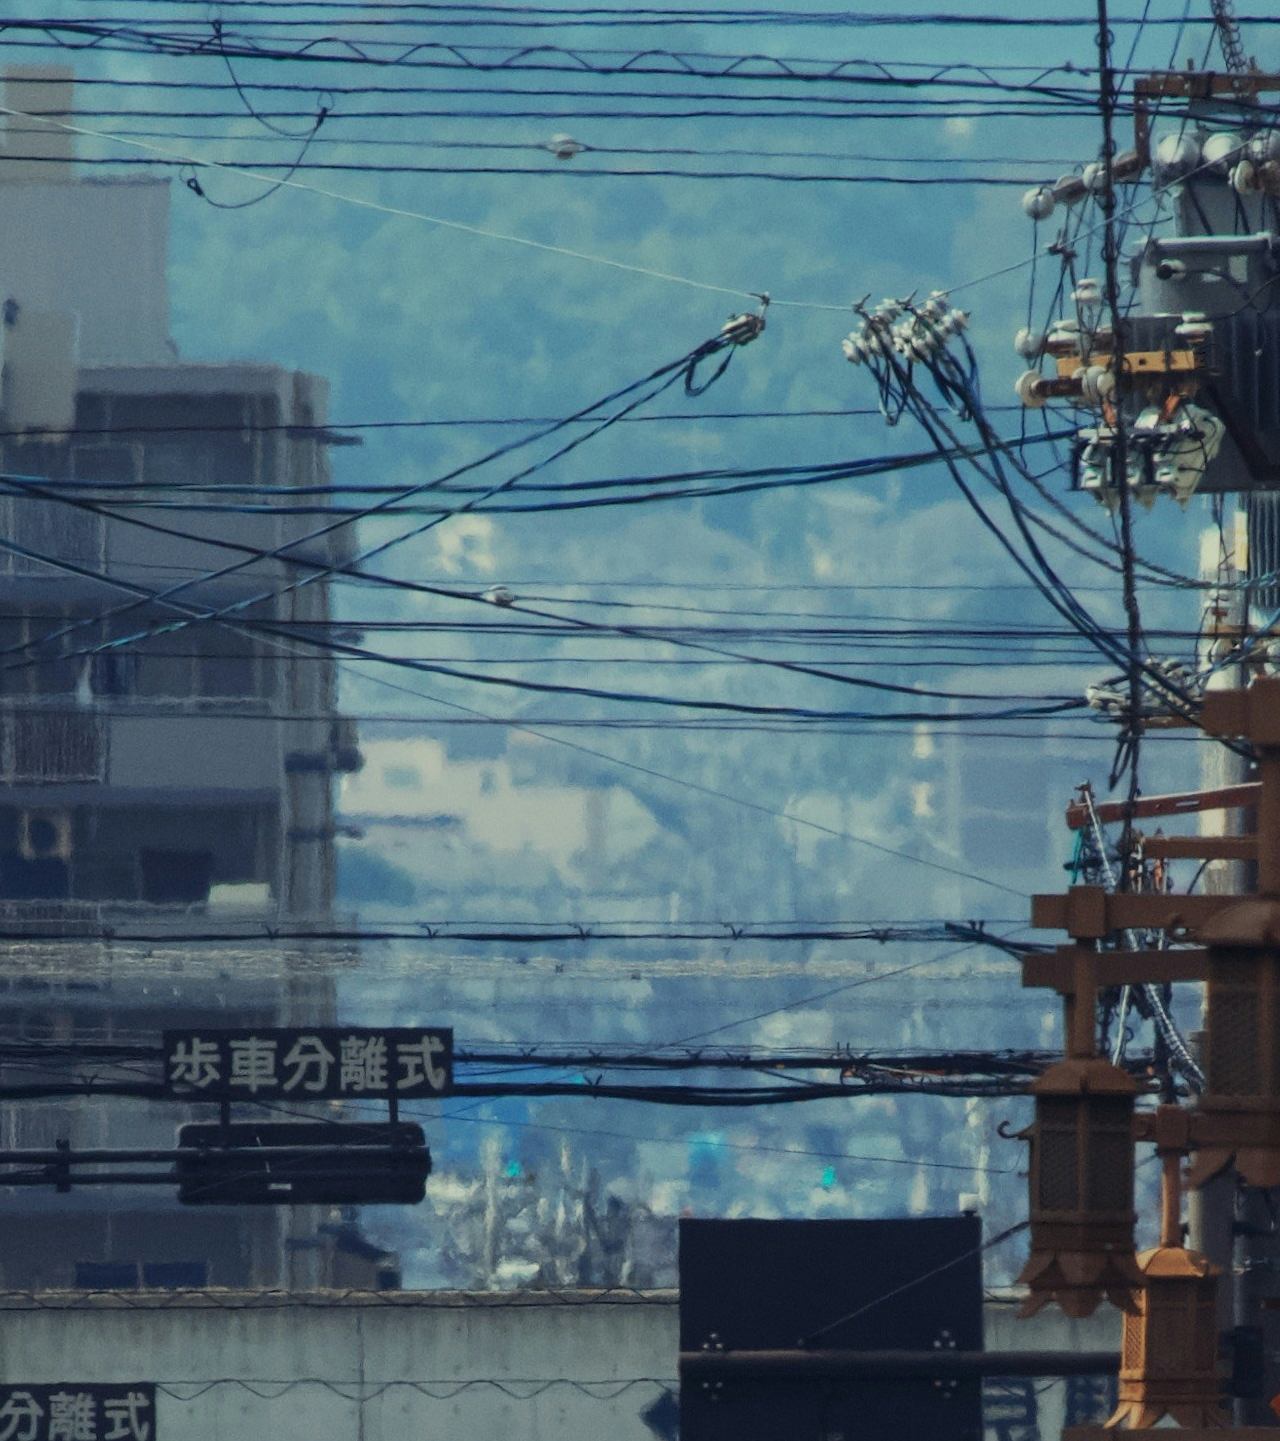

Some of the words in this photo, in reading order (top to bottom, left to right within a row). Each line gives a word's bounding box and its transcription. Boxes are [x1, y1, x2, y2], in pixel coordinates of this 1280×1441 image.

[169, 1035, 447, 1094] 歩車分離式
